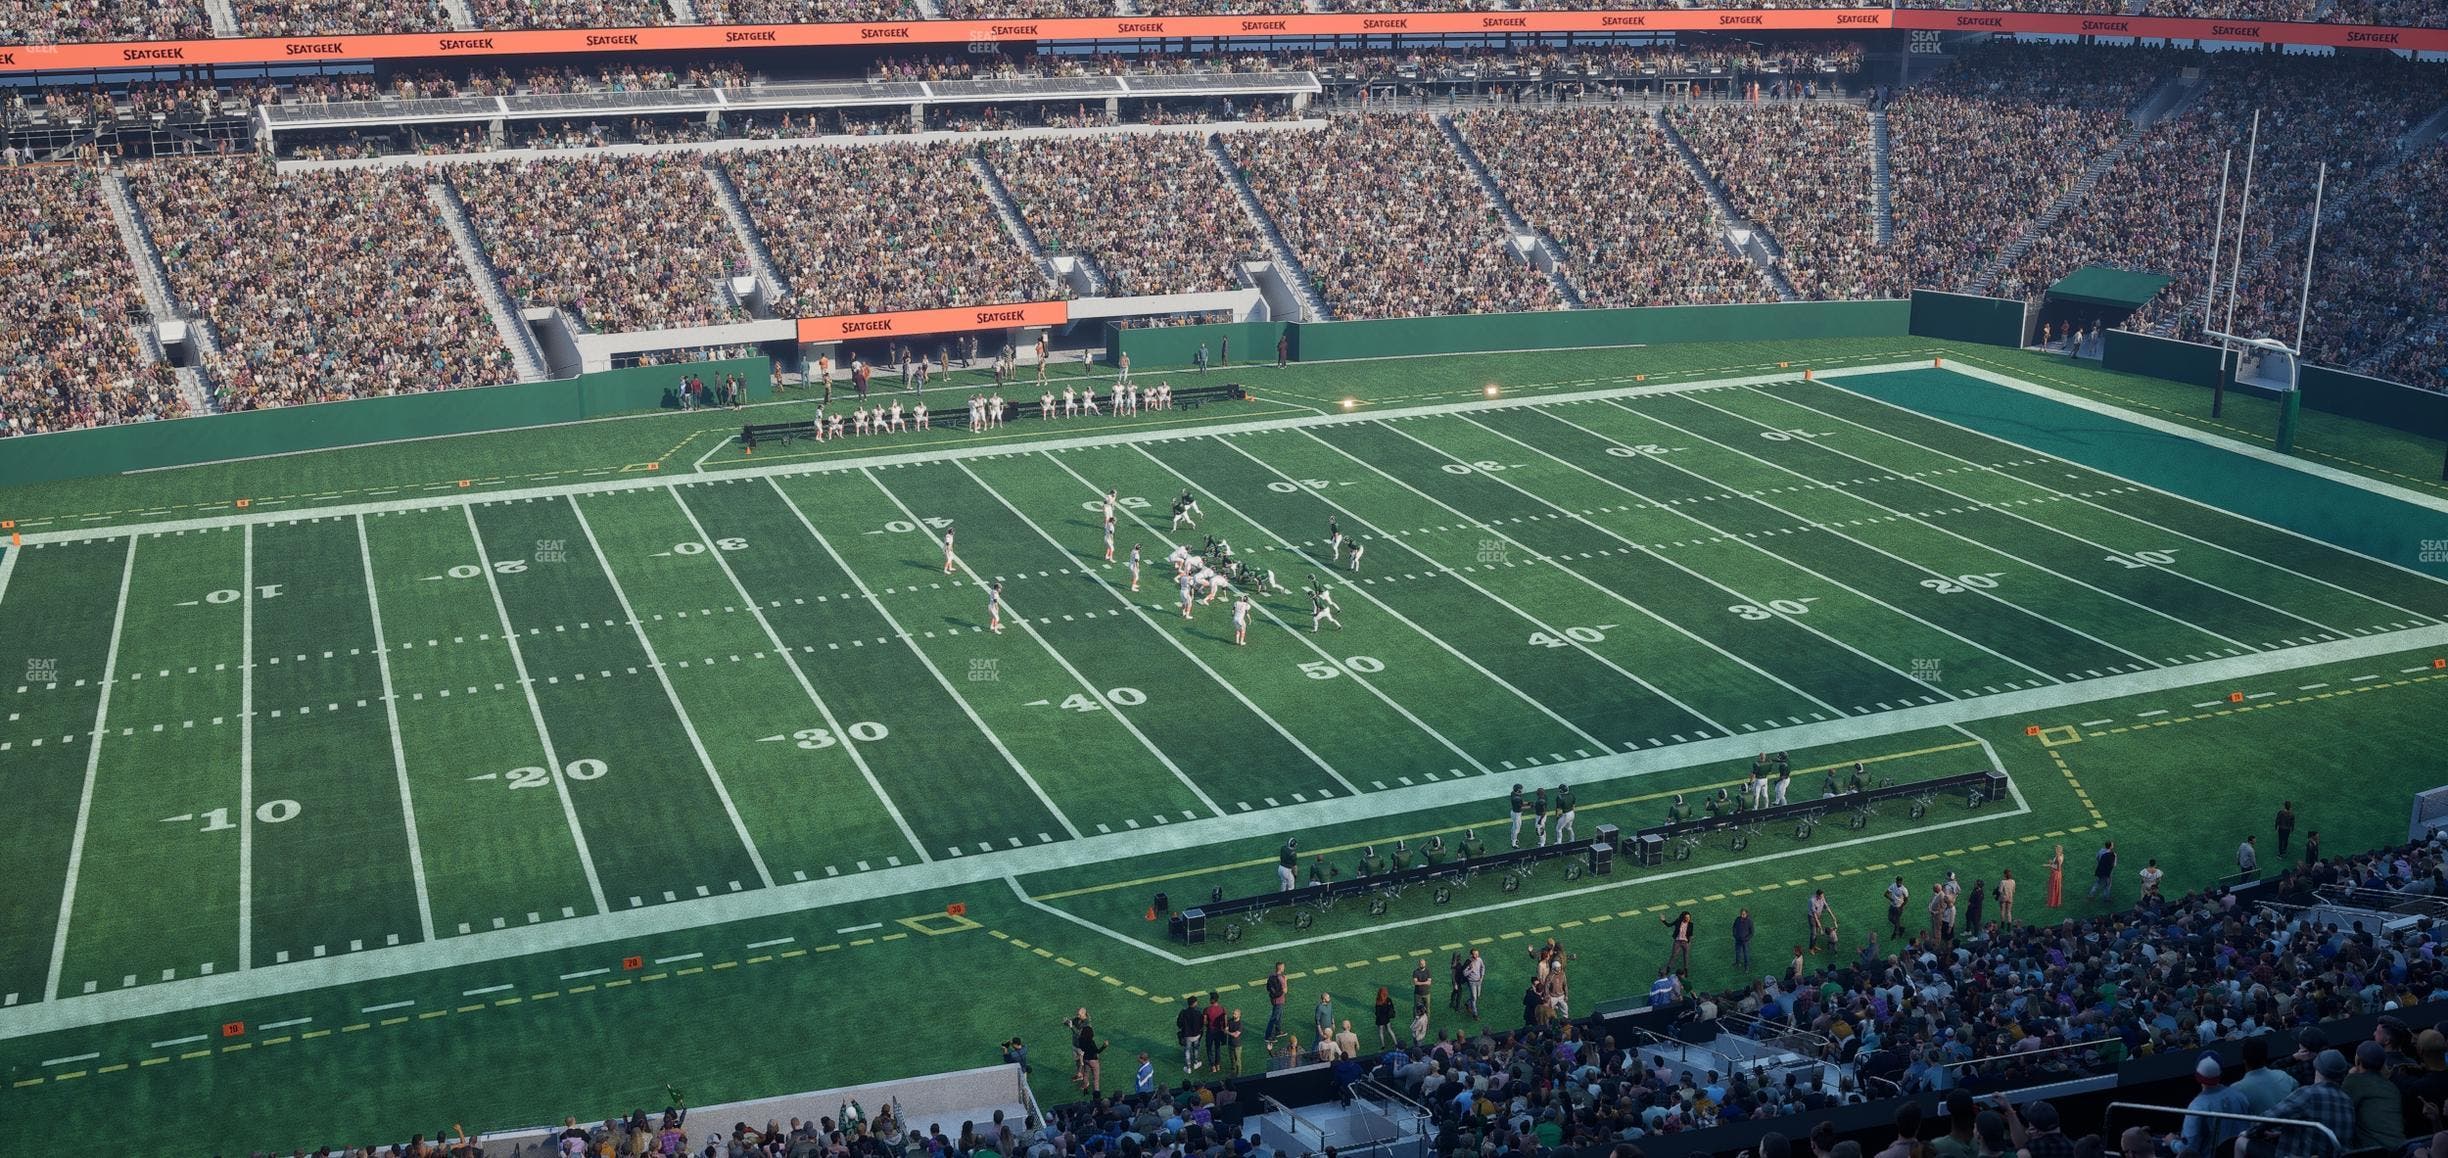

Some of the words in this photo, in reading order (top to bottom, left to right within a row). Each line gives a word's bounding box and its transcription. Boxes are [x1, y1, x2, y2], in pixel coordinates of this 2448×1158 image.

[1242, 20, 1286, 31] SEATGEEK
[1363, 19, 1407, 29] SEATGEEK
[1483, 17, 1526, 28] SEATGEEK
[1602, 16, 1645, 26] SEATGEEK
[1719, 15, 1763, 25] SEATGEEK
[1837, 14, 1879, 24] SEATGEEK
[1957, 16, 2003, 28] SEATGEEK
[991, 25, 1038, 36] SEATGEEK
[1118, 22, 1164, 33] SEATGEEK
[2081, 20, 2129, 32] SEATGEEK
[2211, 25, 2260, 38] SEATGEEK
[586, 34, 638, 46] SEATGEEK
[726, 30, 776, 42] SEATGEEK
[861, 28, 909, 39] SEATGEEK
[2347, 31, 2399, 44] SEATGEEK
[285, 42, 344, 56] SEATGEEK
[439, 38, 494, 51] SEATGEEK
[123, 47, 184, 61] SEATGEEK
[976, 309, 1025, 324] SEATGEEK
[841, 319, 892, 334] SEATGEEK
[1760, 429, 1818, 441] 10
[1605, 444, 1669, 457] 20
[1441, 460, 1507, 475] 30
[1267, 479, 1330, 493] 40
[884, 517, 954, 533] 40
[673, 537, 749, 555] 30
[2103, 551, 2175, 569] 10
[447, 559, 528, 578] 20
[1920, 574, 1999, 594] 20
[205, 584, 283, 604] 10
[1728, 599, 1809, 620] 30
[1528, 626, 1605, 648] 40
[1297, 655, 1385, 680] 50
[1060, 687, 1147, 712] 40
[792, 721, 889, 749] 30
[504, 758, 608, 790] 20
[200, 799, 302, 832] 10
[228, 1024, 239, 1034] 10
